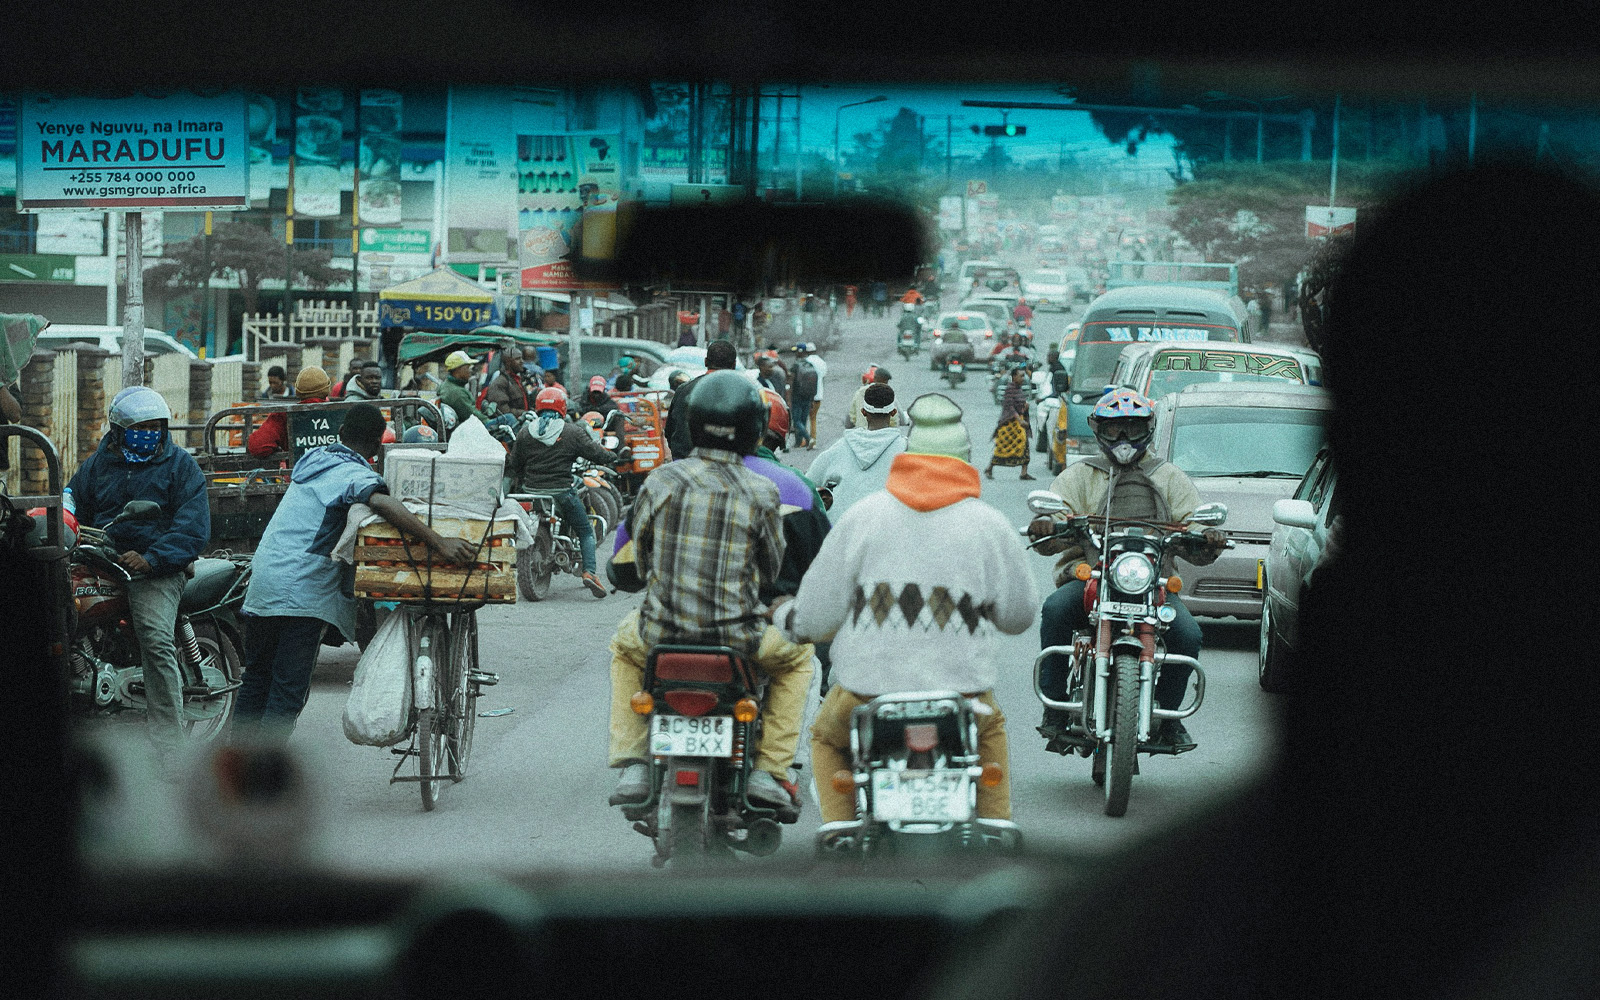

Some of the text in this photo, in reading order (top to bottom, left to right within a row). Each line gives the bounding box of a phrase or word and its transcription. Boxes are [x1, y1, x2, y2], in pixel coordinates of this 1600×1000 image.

[36, 119, 224, 136] Yenye Nguvu, na Imara
[41, 137, 225, 163] MARADUFU
[69, 171, 196, 183] +255 784 000 000
[63, 183, 207, 197] www.gsmgroup.africa
[1105, 327, 1134, 342] YA
[311, 418, 330, 430] YA
[686, 737, 723, 753] BKX
